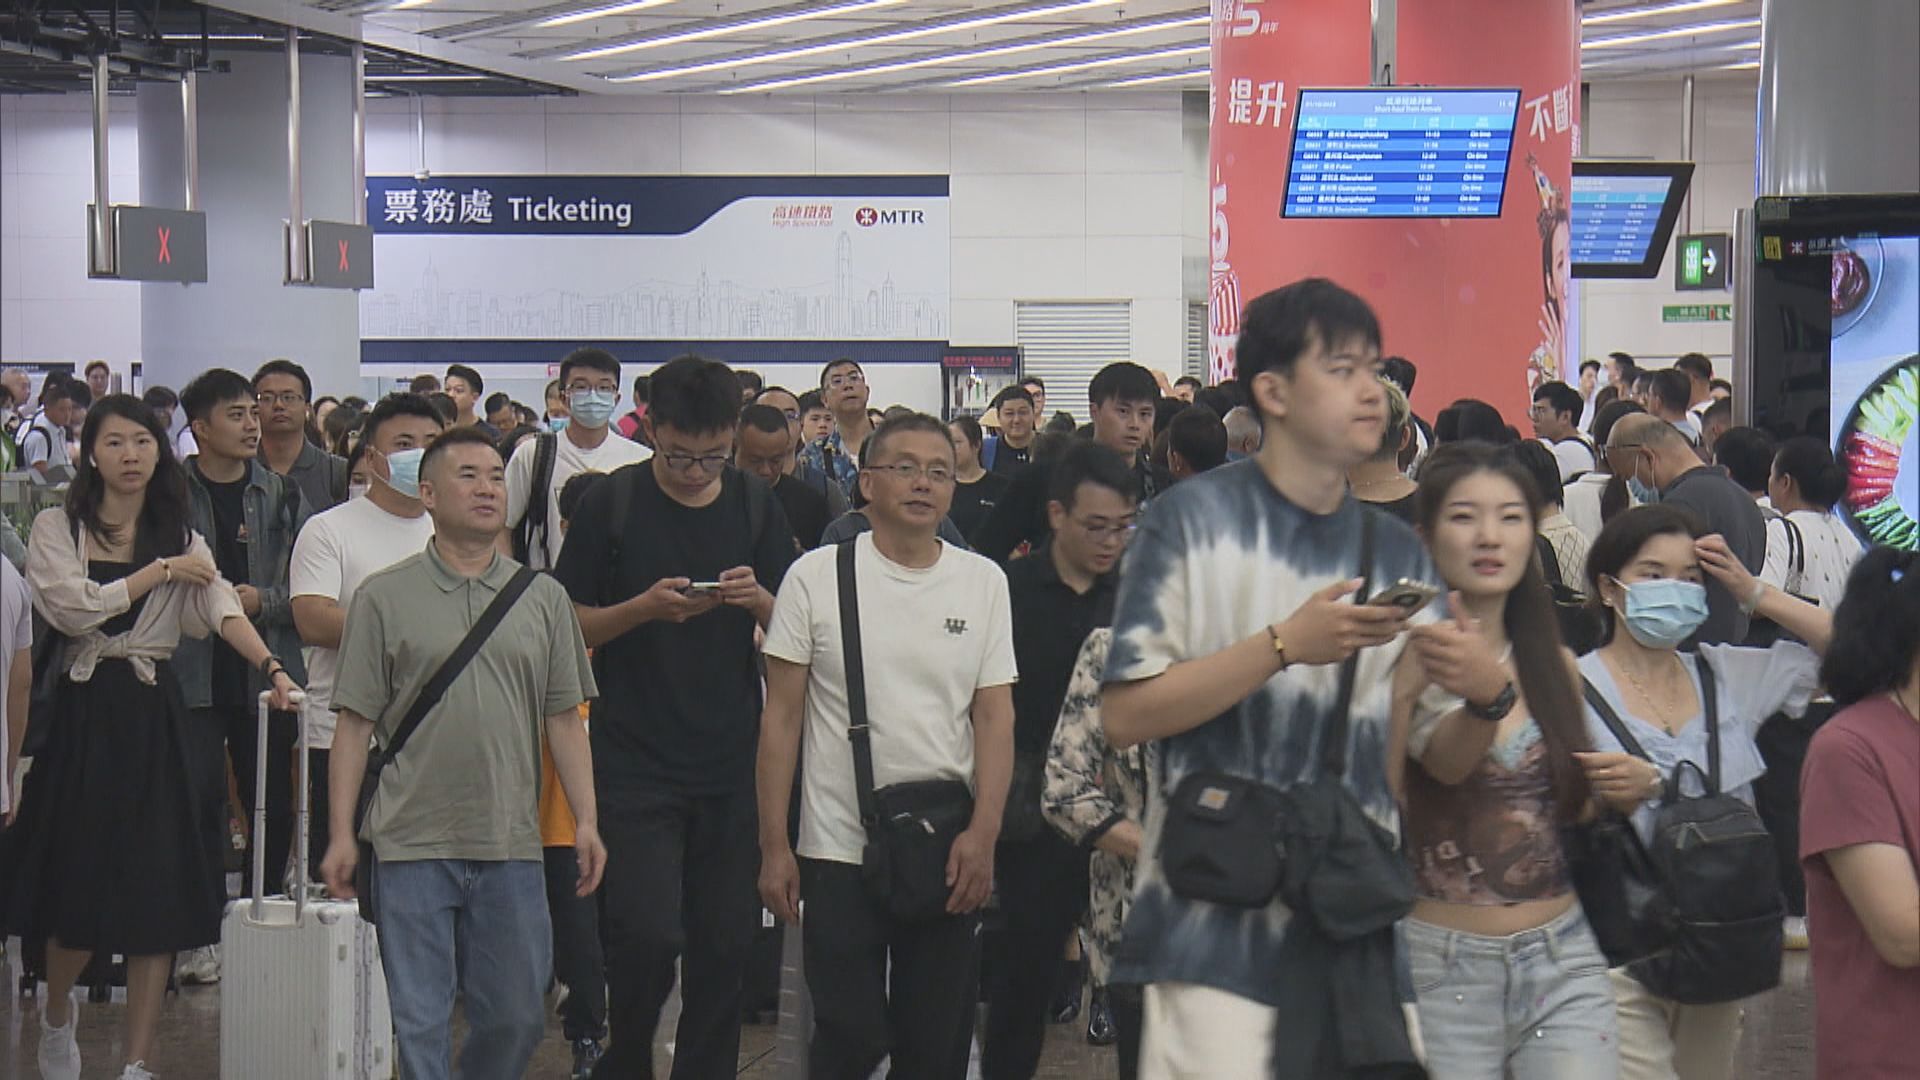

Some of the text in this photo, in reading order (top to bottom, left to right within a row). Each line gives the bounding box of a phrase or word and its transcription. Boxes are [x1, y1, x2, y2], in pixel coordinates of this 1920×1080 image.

[1228, 78, 1287, 128] 提升
[384, 188, 632, 227] 票務處 Ticketing
[881, 210, 925, 224] MTR
